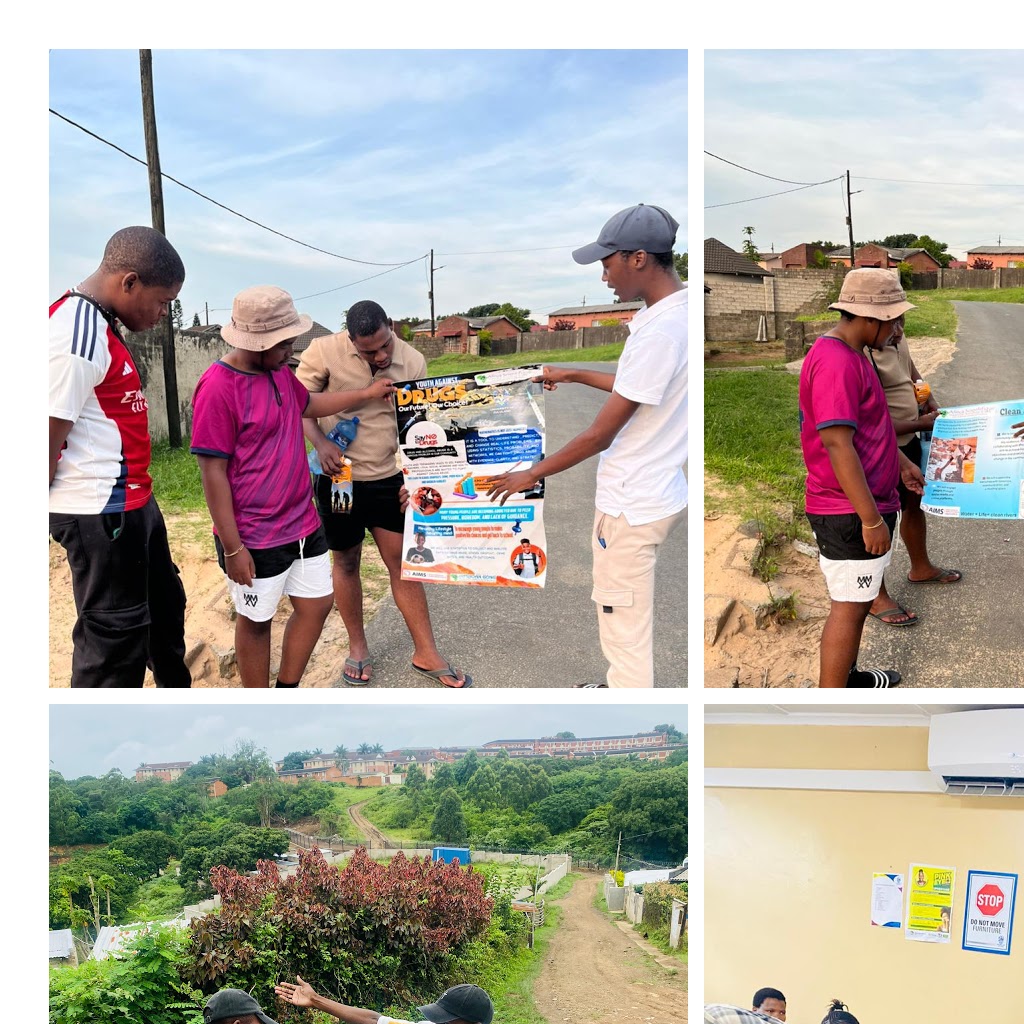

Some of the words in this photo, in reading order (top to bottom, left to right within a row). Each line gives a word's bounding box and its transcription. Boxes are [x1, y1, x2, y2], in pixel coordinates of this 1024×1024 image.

[416, 381, 434, 389] YOUTH
[435, 377, 458, 387] AGAINST
[397, 384, 467, 405] DRUGS
[1000, 408, 1020, 416] Clean
[978, 893, 1003, 907] STOP
[990, 920, 1005, 928] MOVE
[972, 925, 1001, 934] FURNITURE
